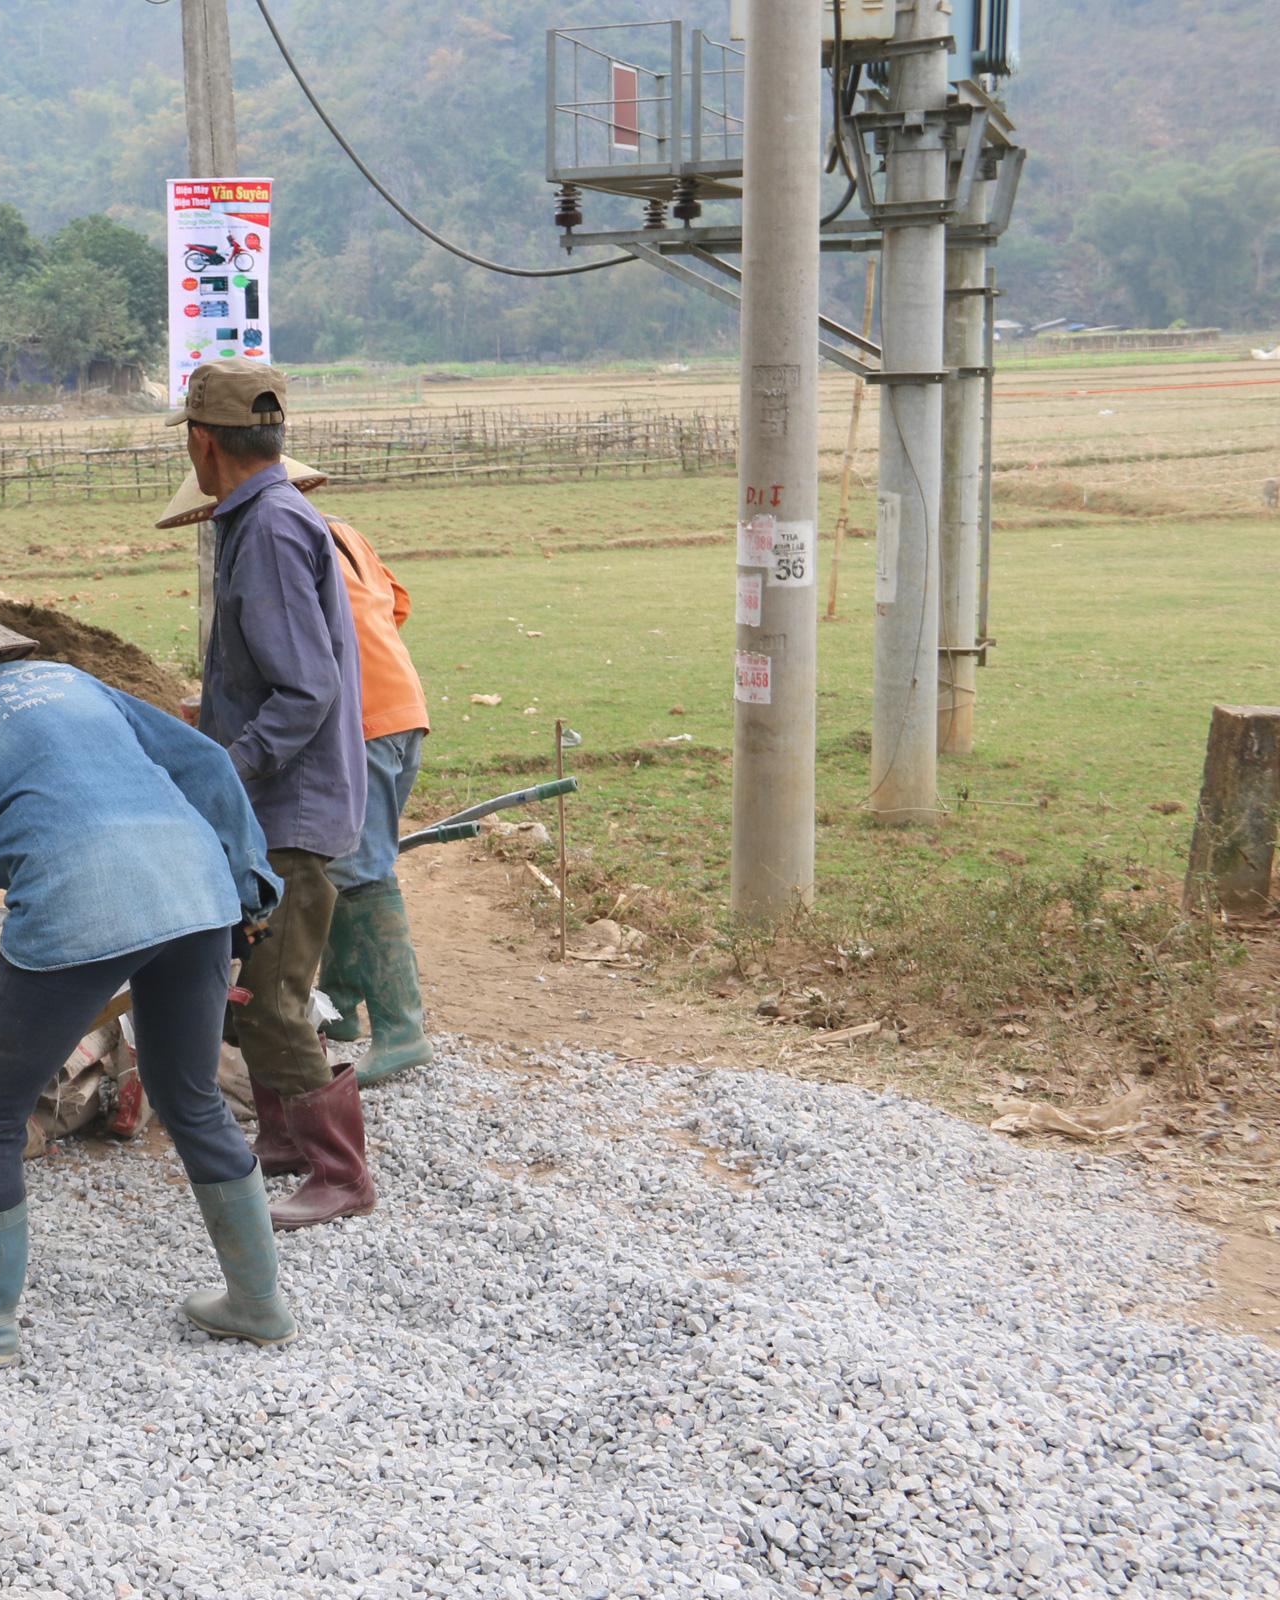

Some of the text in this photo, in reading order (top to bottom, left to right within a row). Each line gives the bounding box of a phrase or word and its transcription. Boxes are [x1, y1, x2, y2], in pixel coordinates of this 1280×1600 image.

[212, 185, 269, 202] Văn Suyên
[775, 557, 805, 581] 56
